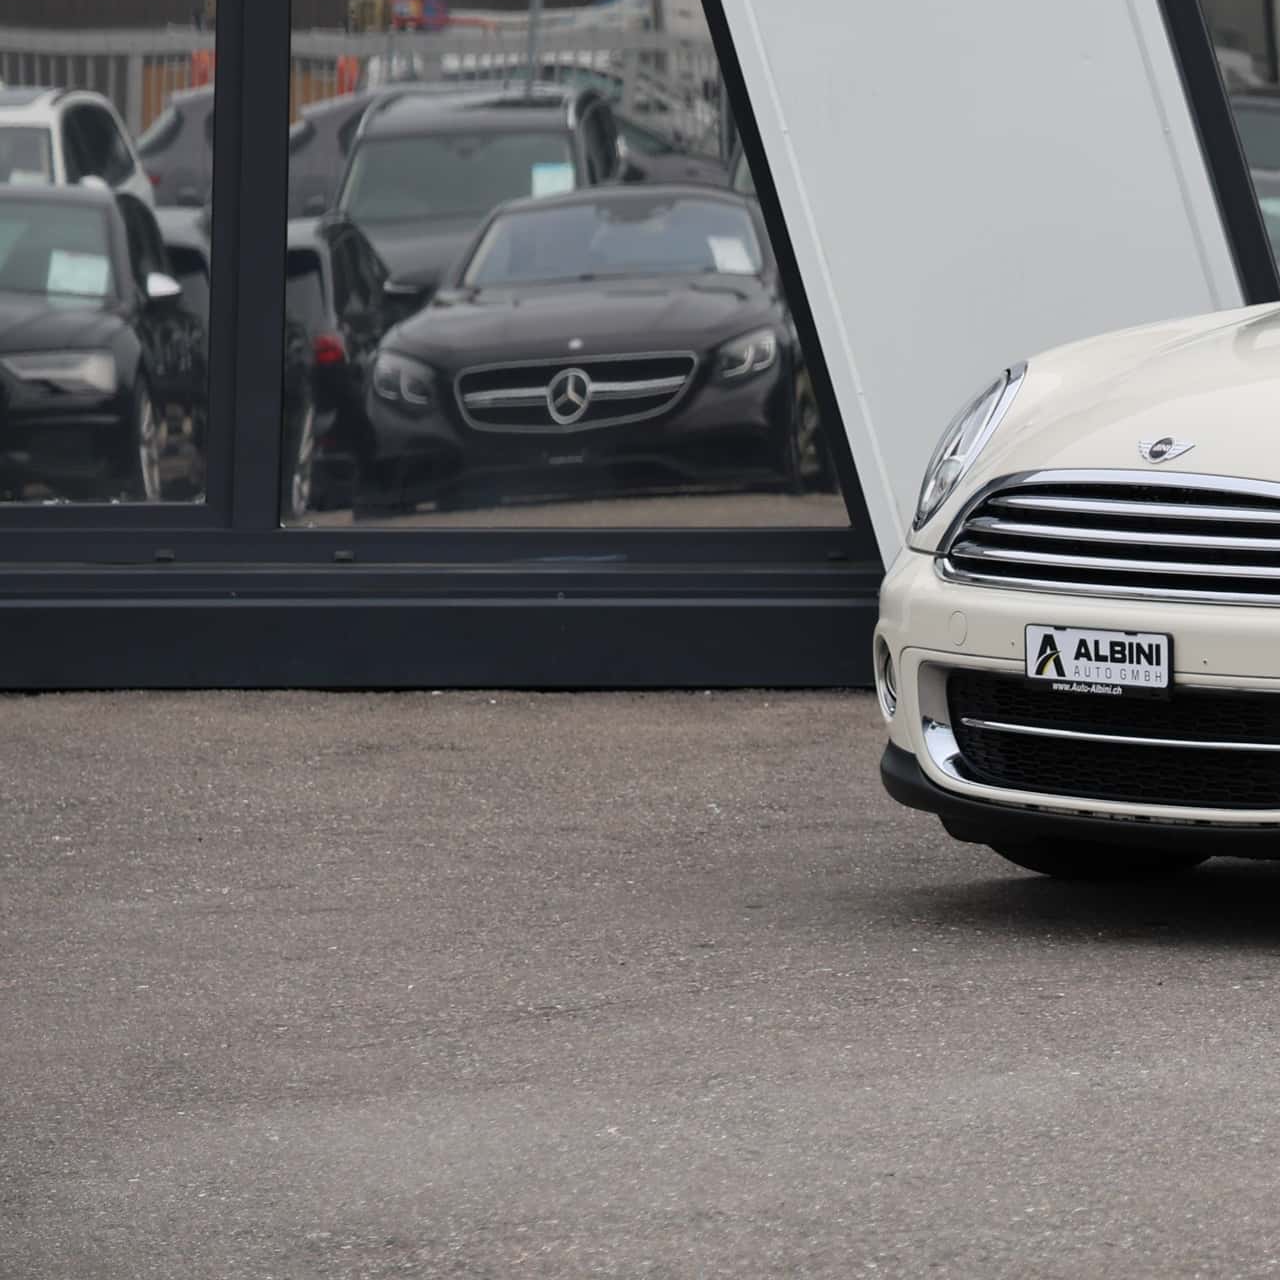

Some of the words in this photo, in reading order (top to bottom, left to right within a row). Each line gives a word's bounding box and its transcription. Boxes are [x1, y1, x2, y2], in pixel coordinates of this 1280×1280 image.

[1073, 638, 1162, 667] ALBINI
[1073, 665, 1113, 680] AUTO
[1120, 668, 1163, 683] GMBH
[1052, 682, 1123, 696] www.Auto-Albini.ch
